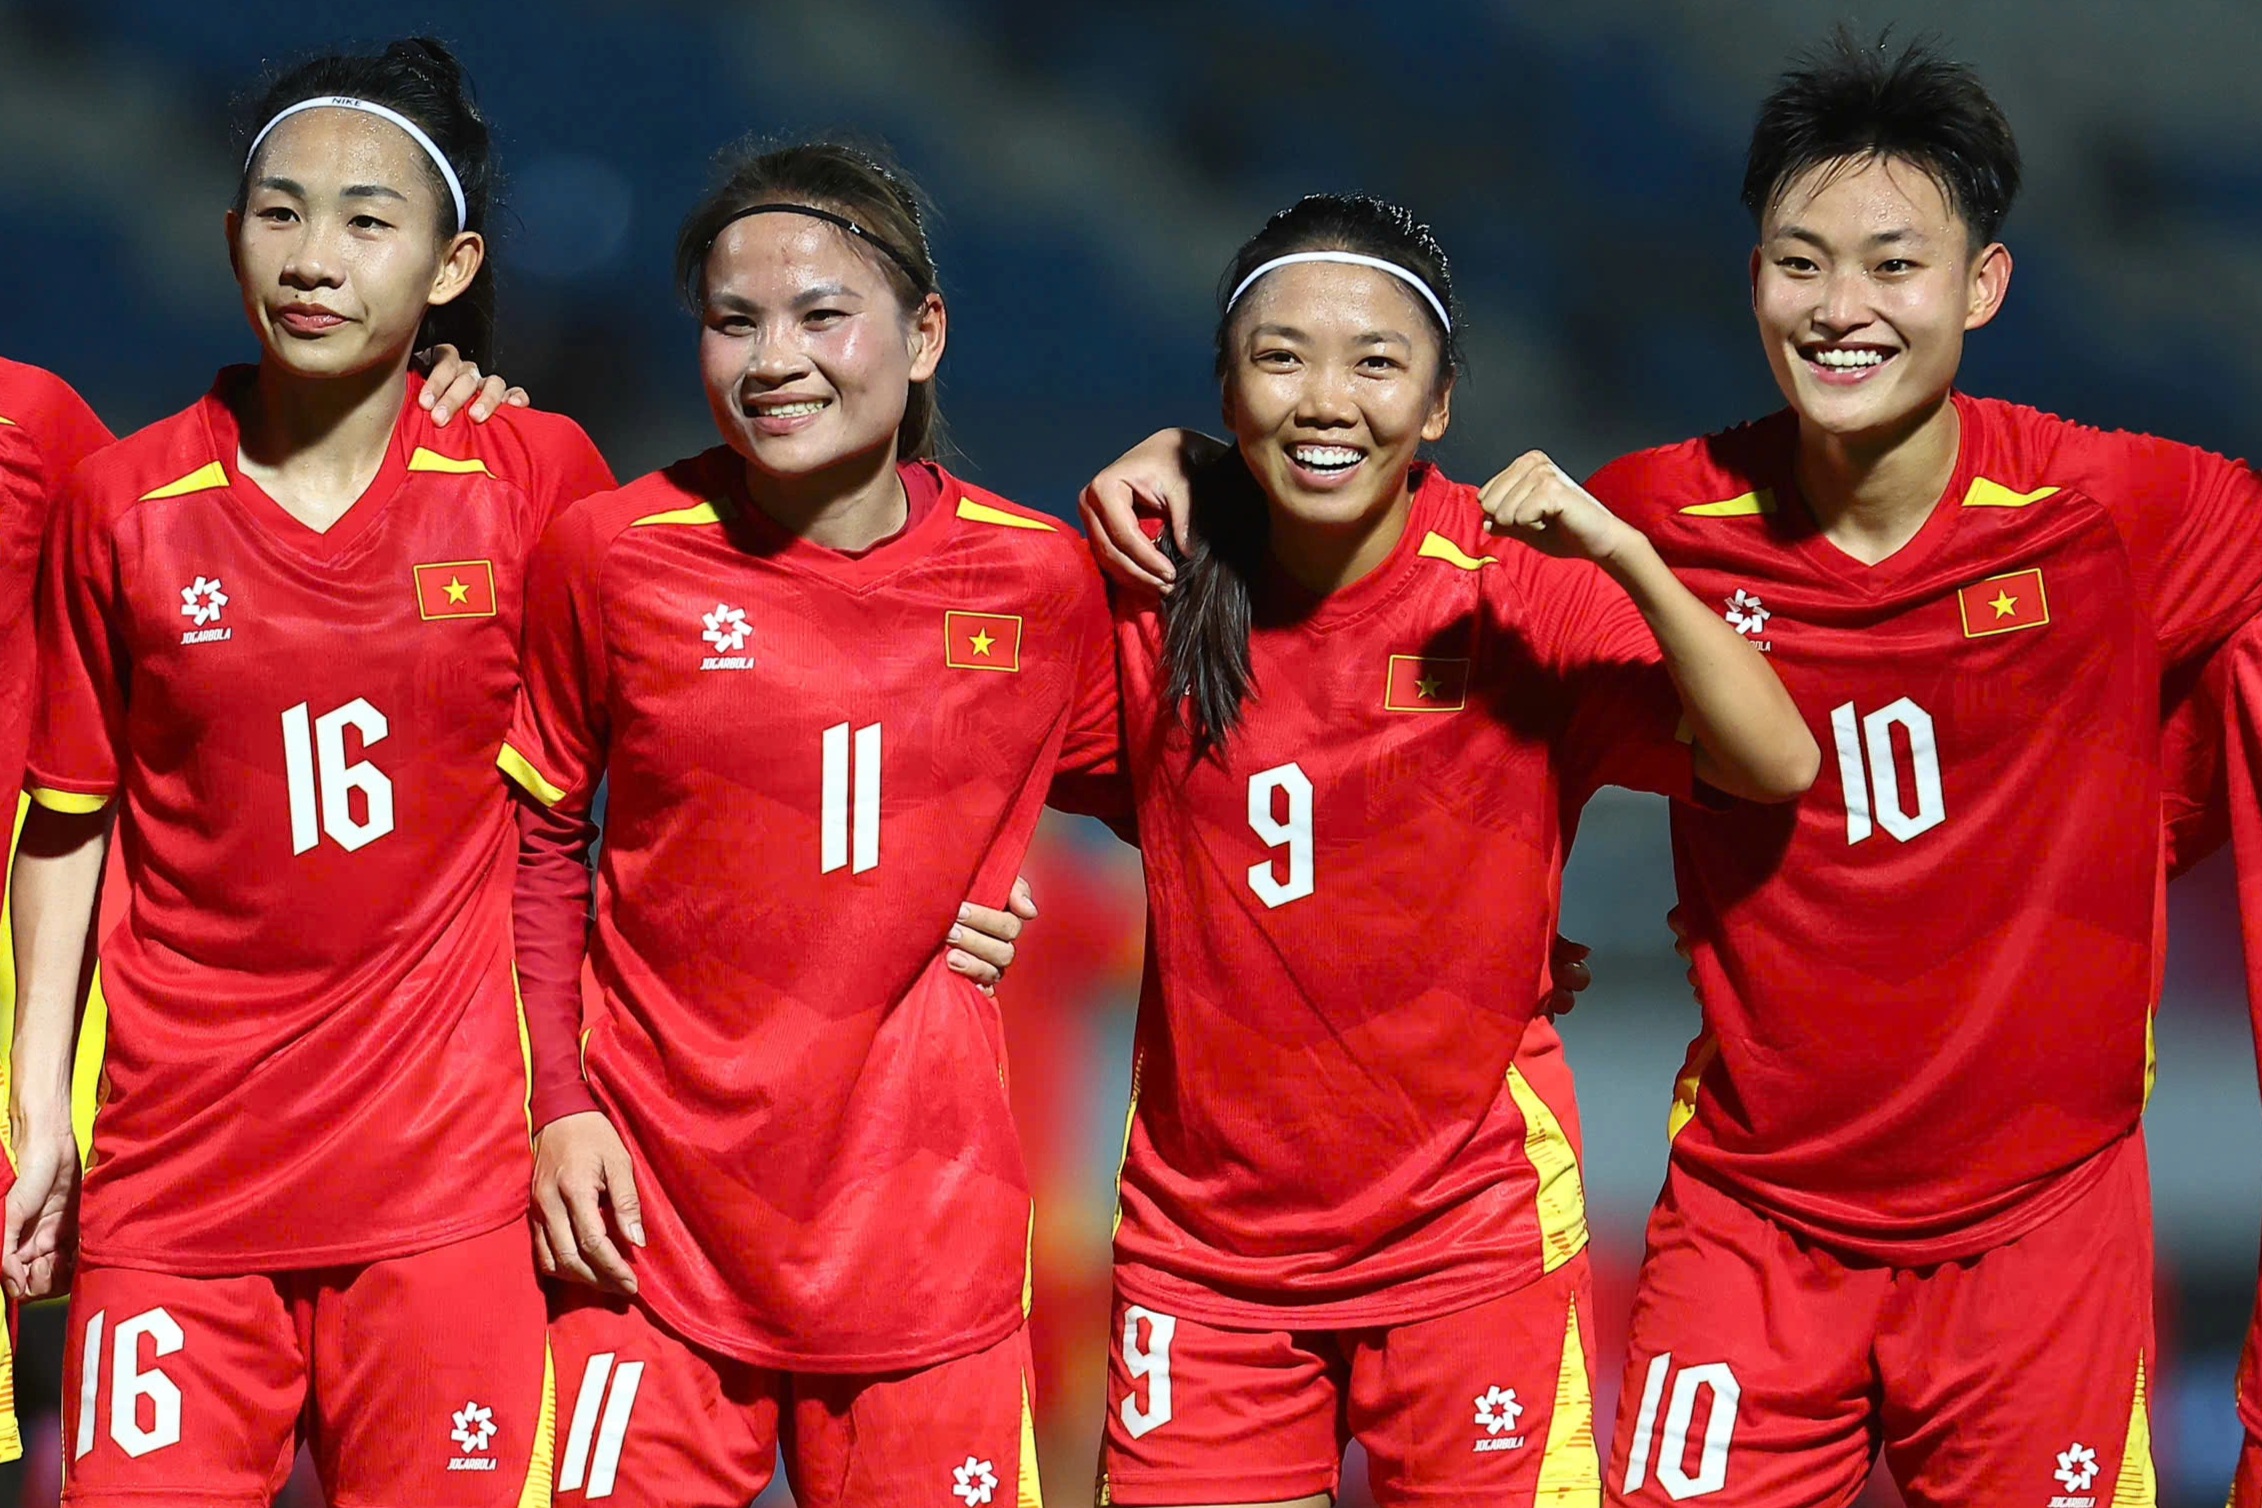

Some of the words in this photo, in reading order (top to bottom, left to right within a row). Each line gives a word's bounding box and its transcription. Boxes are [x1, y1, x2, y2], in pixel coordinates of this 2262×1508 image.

[332, 97, 361, 107] NIKE
[282, 697, 394, 855] 16
[822, 721, 882, 874] 11
[1248, 762, 1314, 909] 9
[1830, 696, 1946, 846] 10
[75, 1306, 185, 1460] 16
[558, 1352, 645, 1499] 11
[1120, 1305, 1178, 1440] 9
[1622, 1352, 1741, 1501] 10
